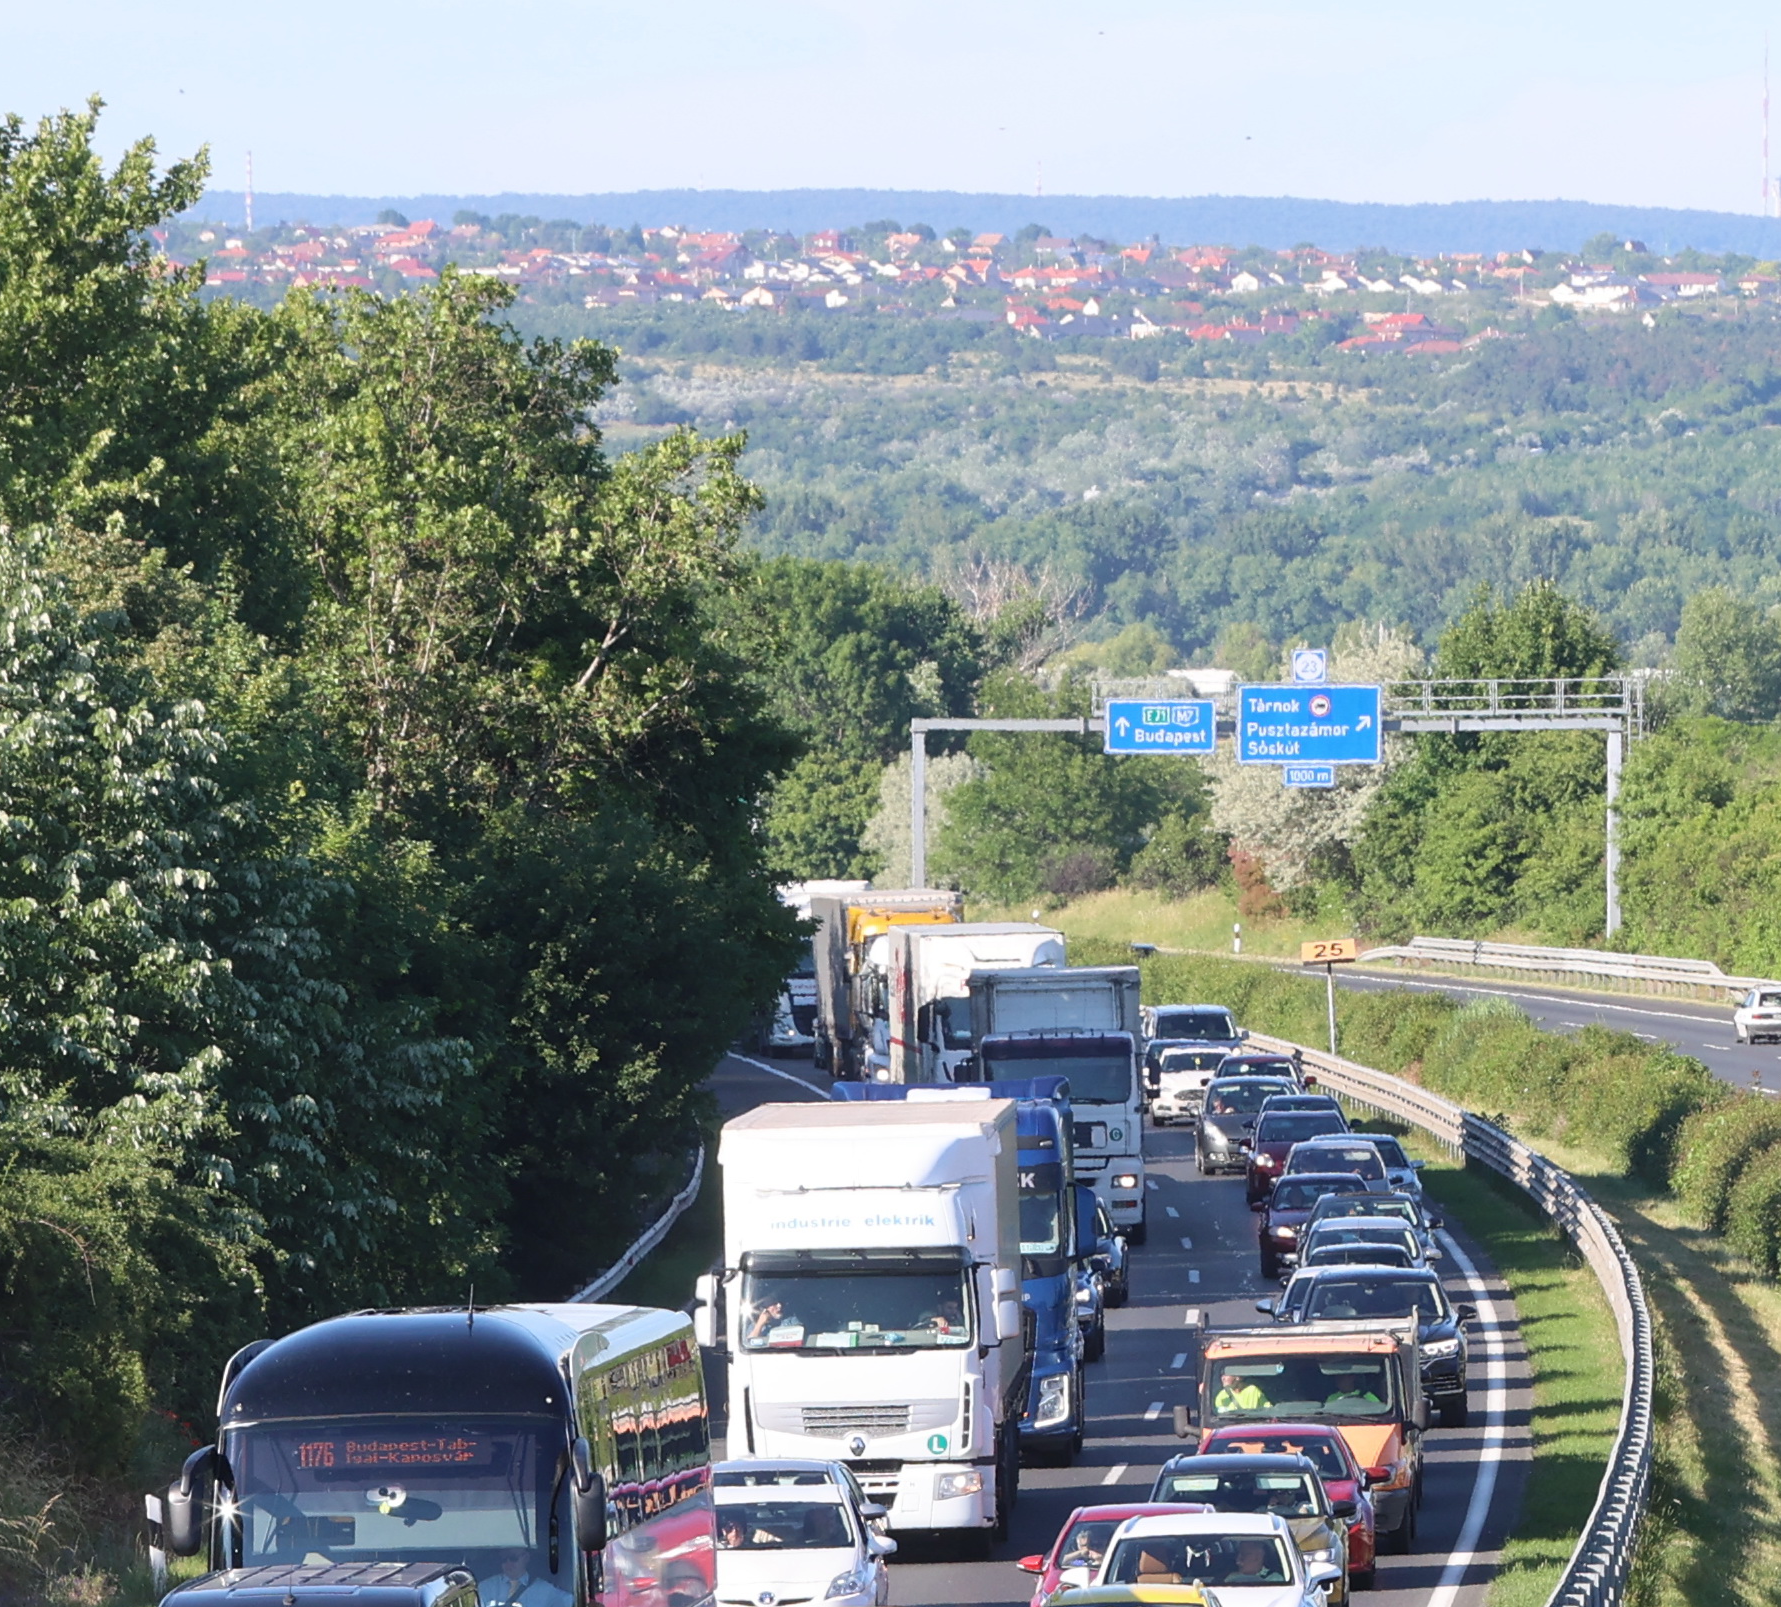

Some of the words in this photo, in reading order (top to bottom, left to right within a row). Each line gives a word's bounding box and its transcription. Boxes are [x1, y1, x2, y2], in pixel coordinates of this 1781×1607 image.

[1301, 660, 1318, 673] 23
[1248, 697, 1301, 713] Tárnok
[1176, 710, 1195, 722] M7
[1134, 728, 1206, 747] Budapest
[1247, 721, 1350, 738] Pusztazámor
[1247, 739, 1301, 756] Sóskút
[1289, 769, 1315, 782] 1000
[1317, 772, 1329, 782] m
[1314, 942, 1344, 959] 25
[771, 1217, 851, 1230] industrie
[864, 1213, 935, 1228] elektrik
[932, 1436, 945, 1452] L
[297, 1441, 335, 1468] 1176
